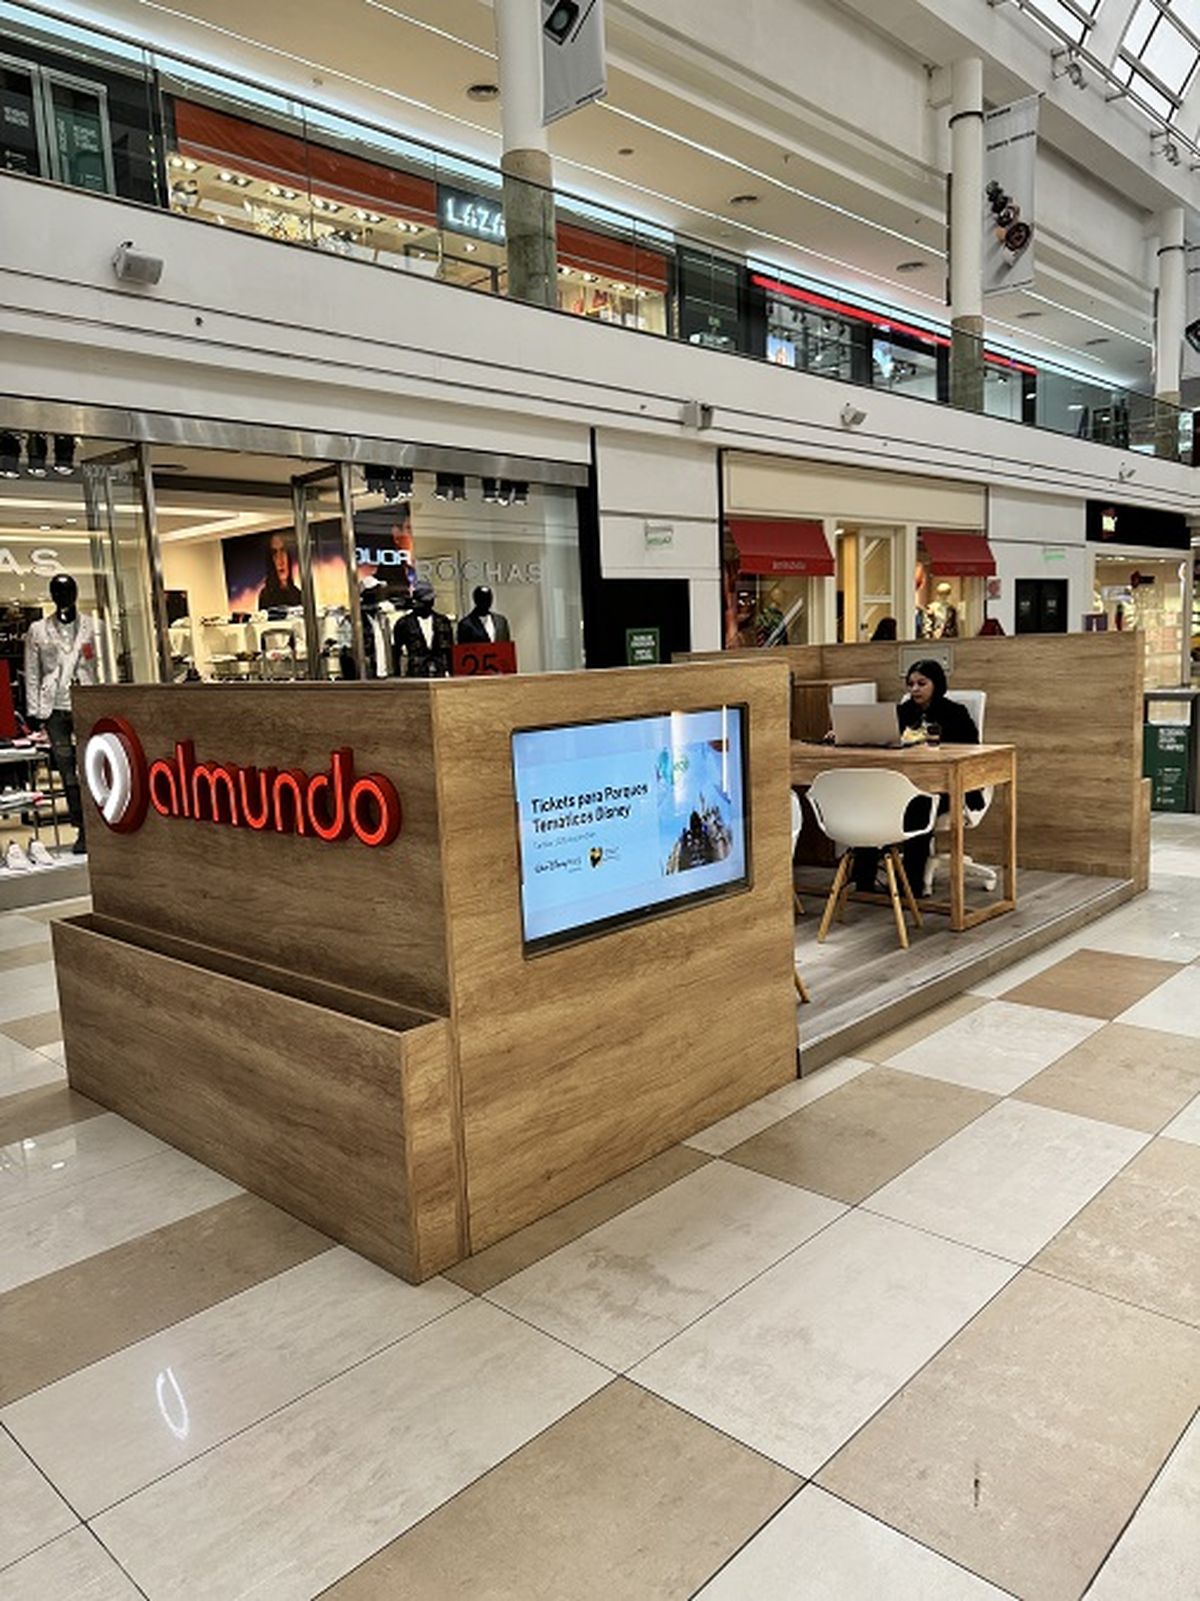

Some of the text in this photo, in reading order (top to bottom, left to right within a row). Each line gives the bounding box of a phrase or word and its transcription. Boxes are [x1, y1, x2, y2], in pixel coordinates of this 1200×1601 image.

[416, 560, 541, 583] ROCHAS
[150, 742, 398, 847] almundo
[531, 783, 648, 814] Tickets para Parques
[595, 804, 631, 822] Disney
